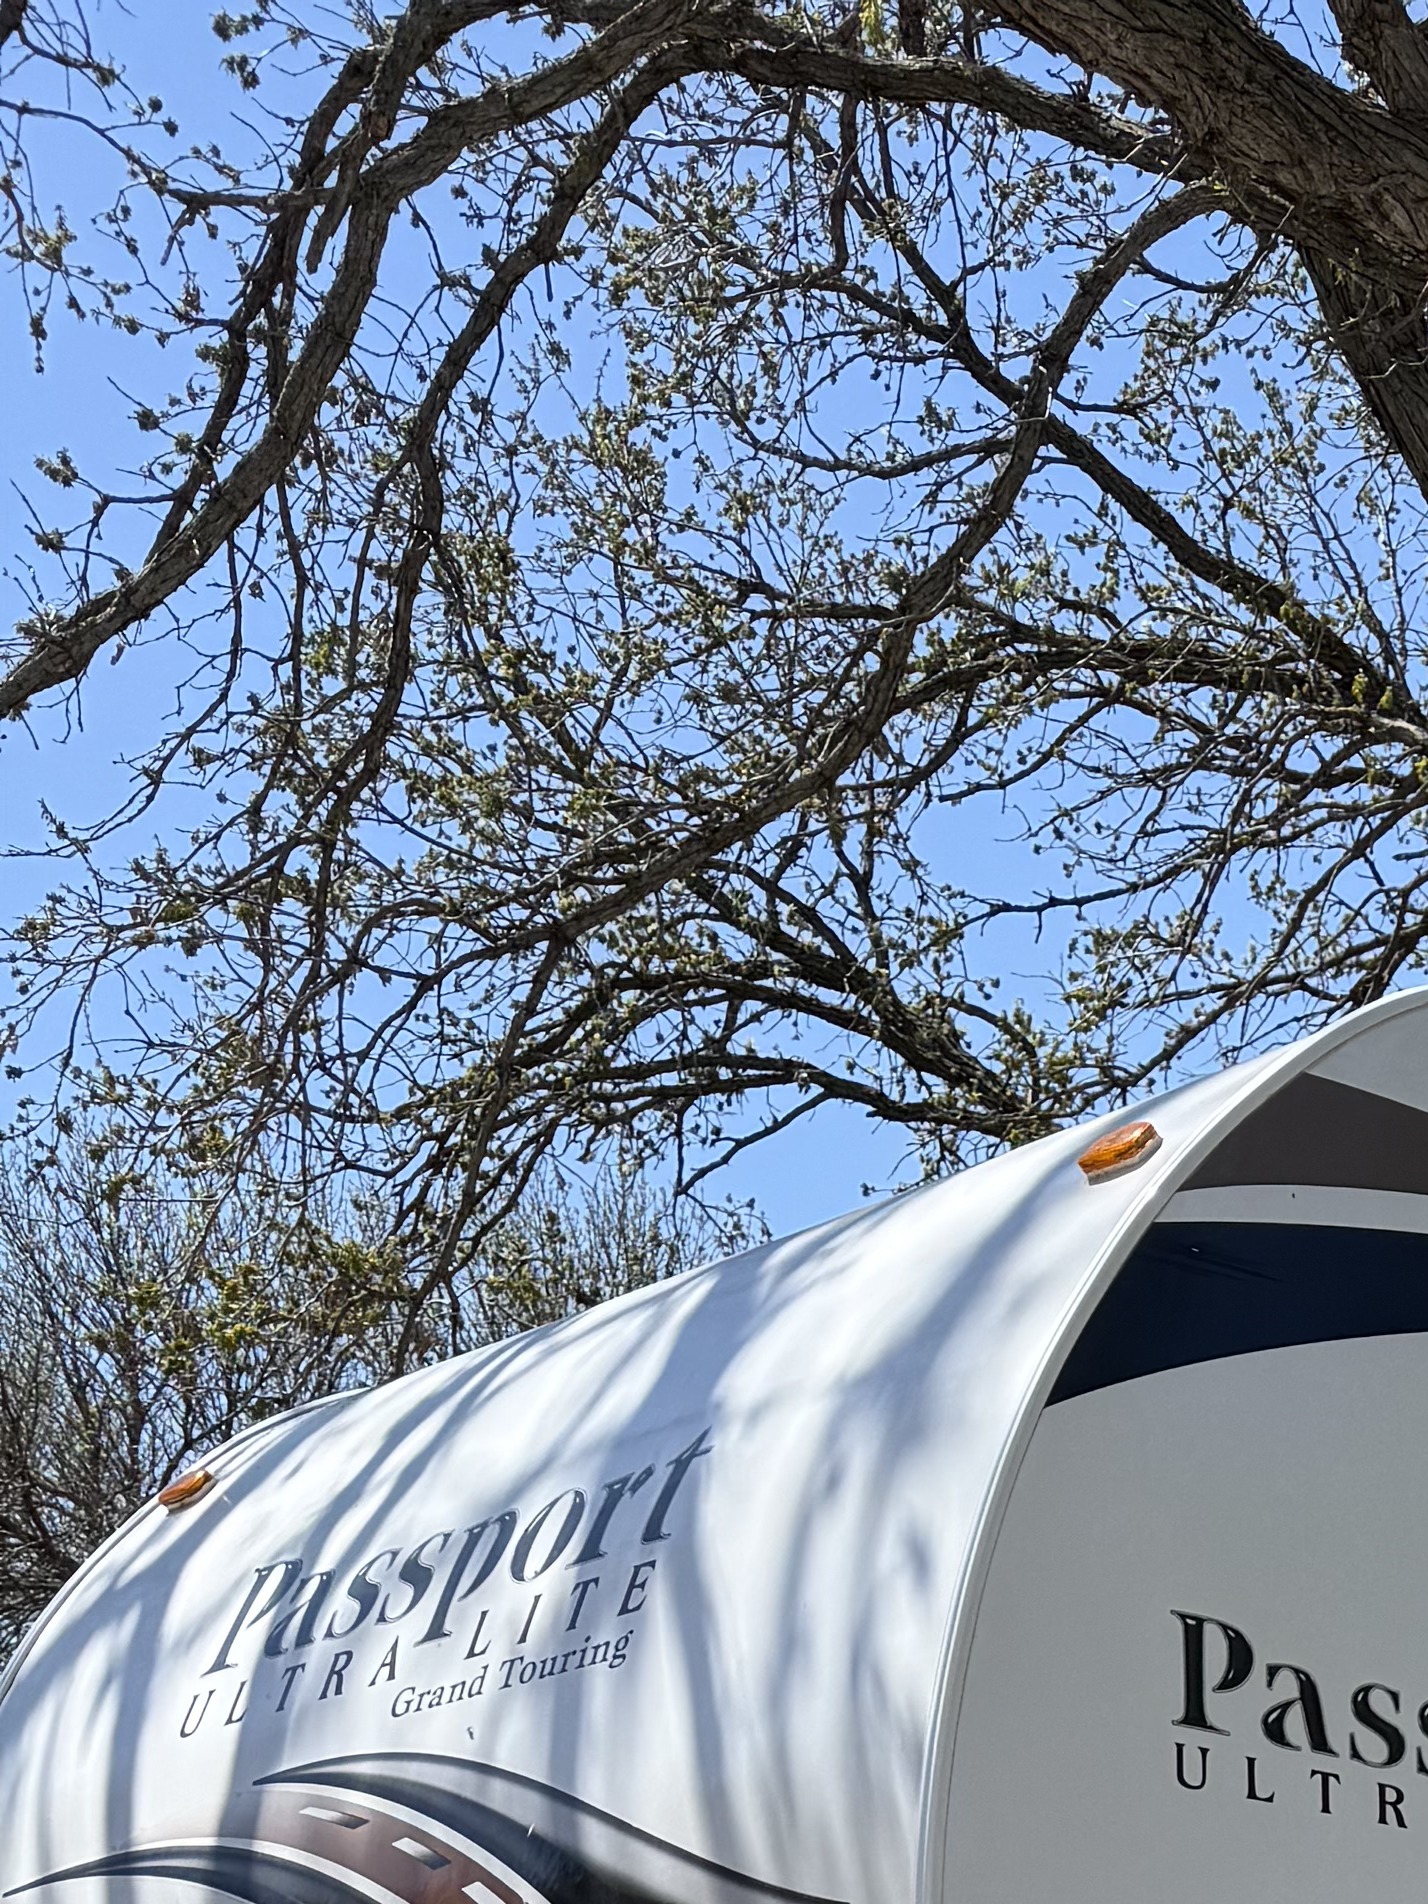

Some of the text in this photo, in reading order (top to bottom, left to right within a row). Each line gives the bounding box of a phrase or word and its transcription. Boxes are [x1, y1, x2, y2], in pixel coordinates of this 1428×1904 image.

[202, 1425, 715, 1679] Passport
[391, 1629, 635, 1719] Grand Touring
